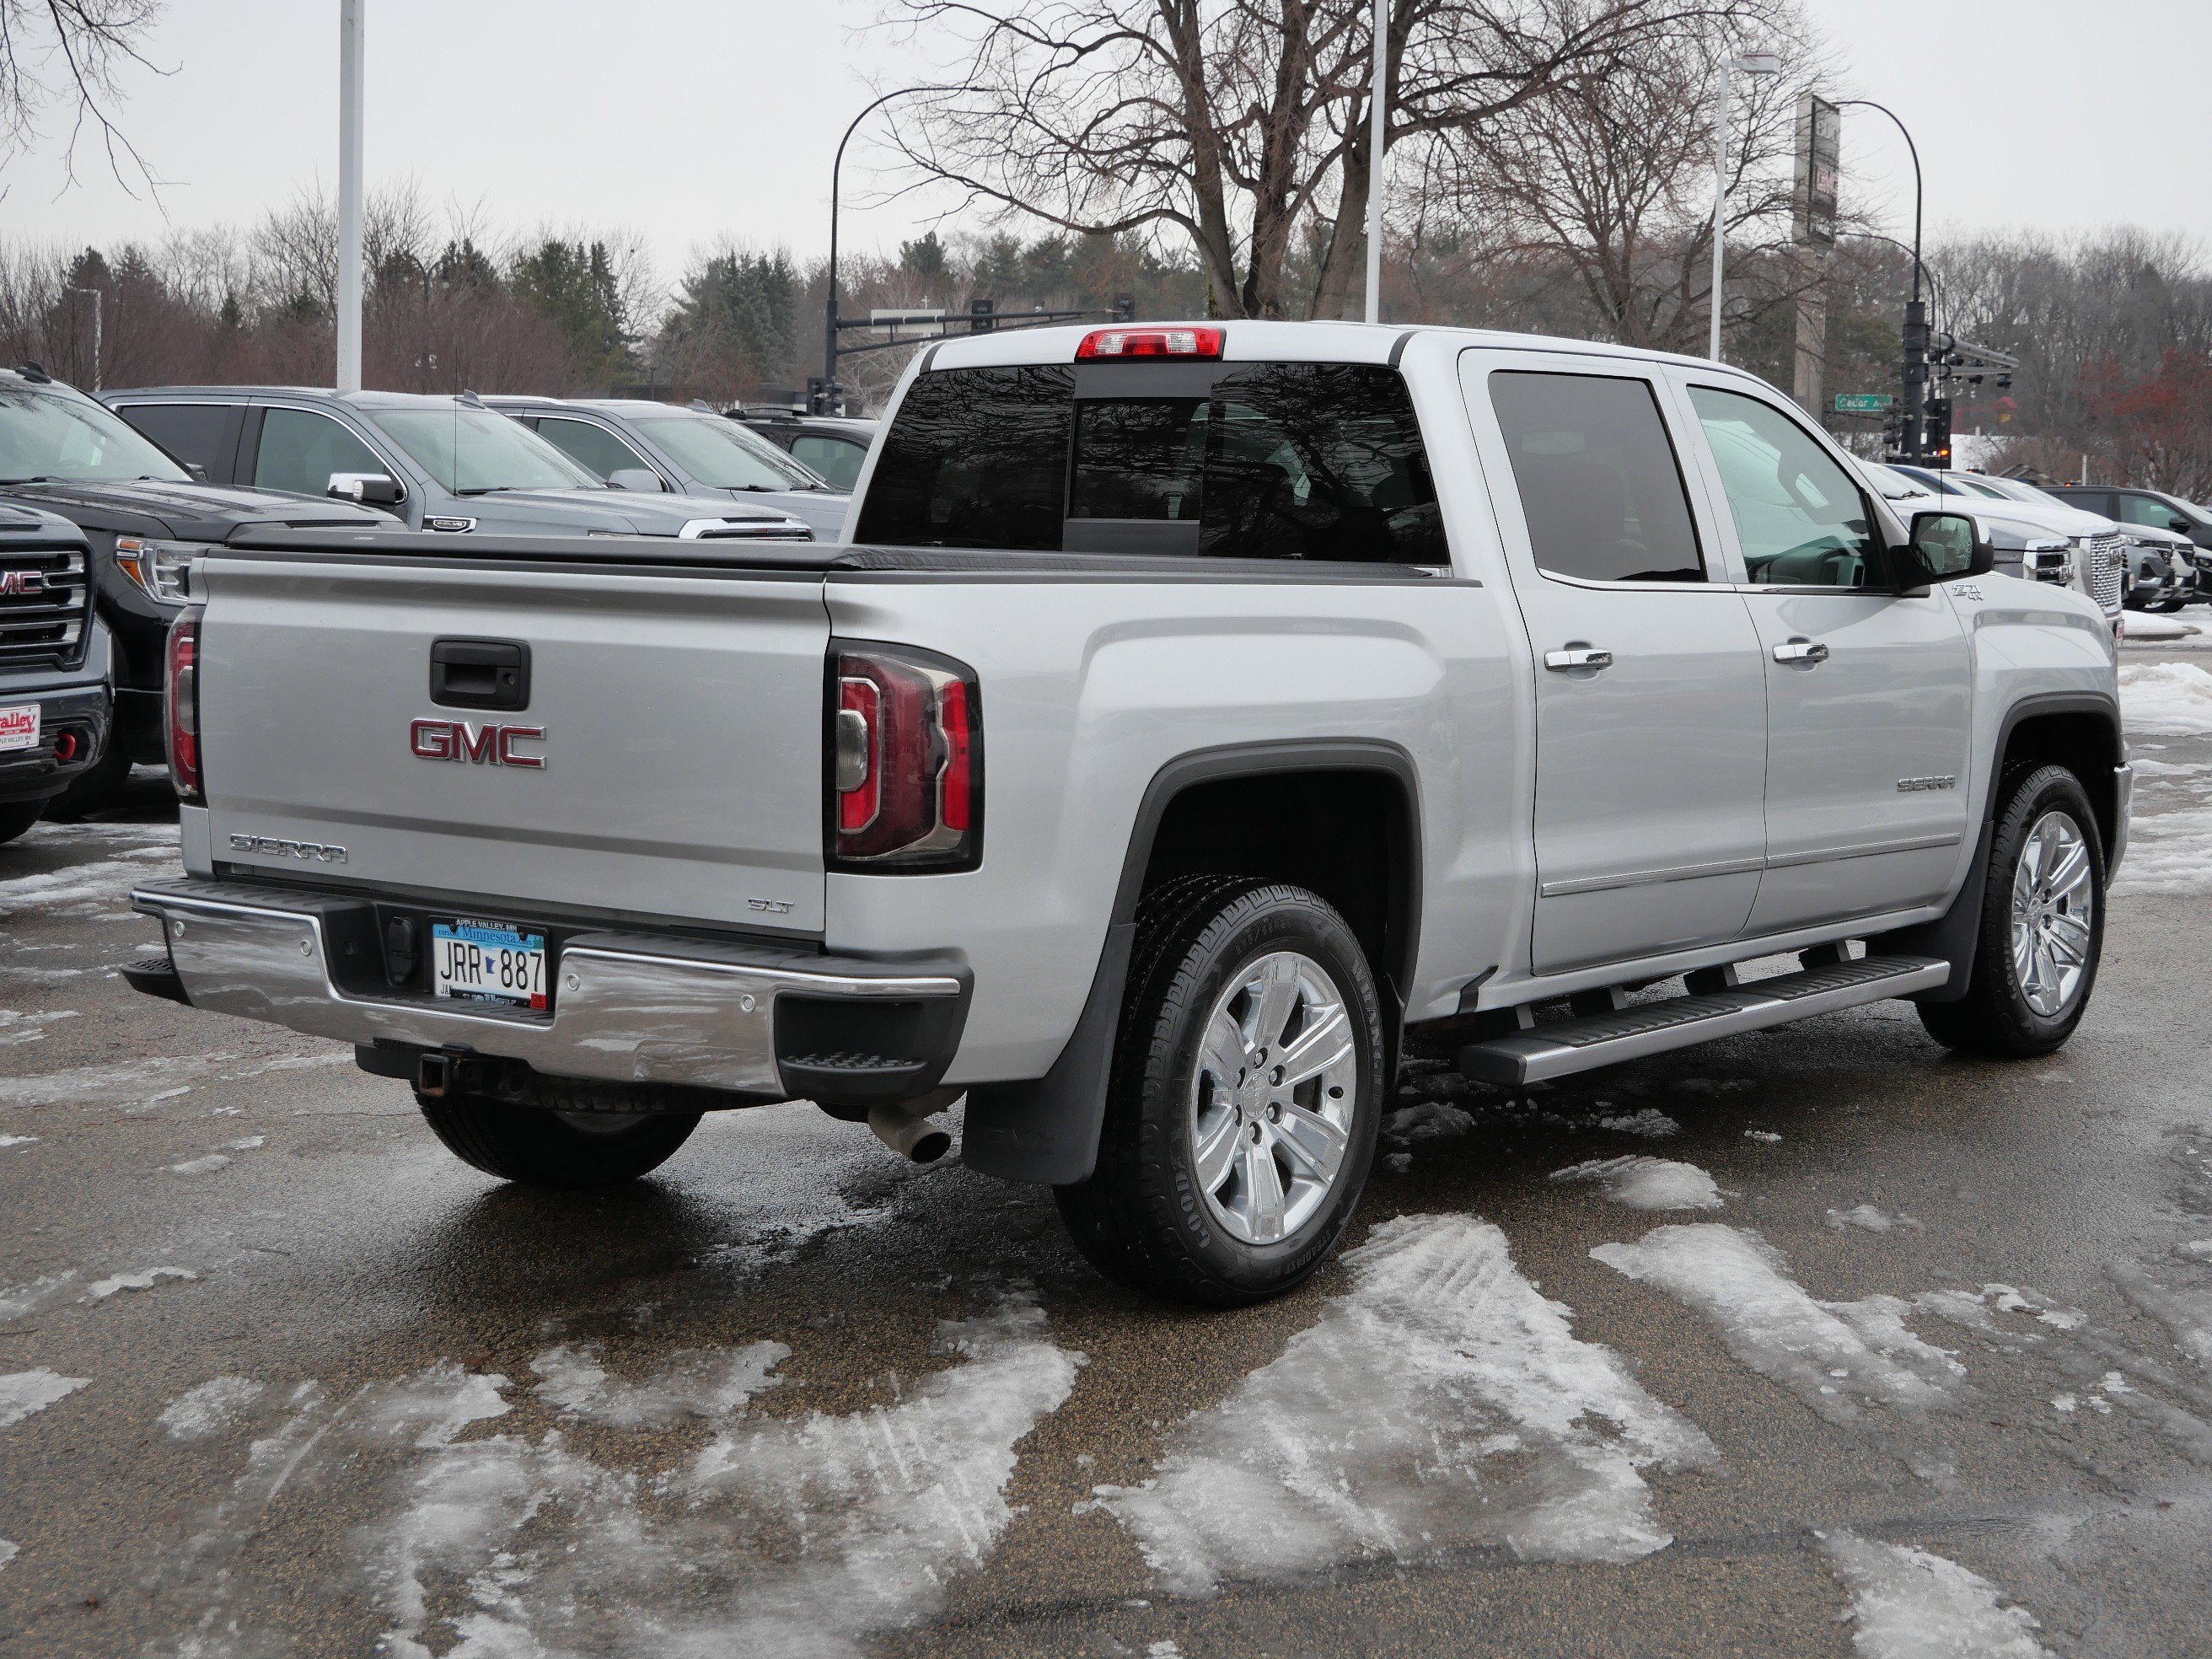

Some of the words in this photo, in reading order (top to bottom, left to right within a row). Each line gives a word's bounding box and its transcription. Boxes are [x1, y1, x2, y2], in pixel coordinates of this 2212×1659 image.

[1839, 398, 1868, 408] Cedar
[0, 571, 43, 595] MC
[0, 712, 36, 733] alley
[410, 717, 547, 770] GMC
[1897, 775, 1956, 792] SIERRA
[229, 833, 349, 864] SIERRA
[748, 898, 795, 914] SLT
[456, 919, 477, 927] APPLE
[506, 924, 518, 932] MN
[440, 942, 482, 985] JRR
[500, 948, 542, 992] 887
